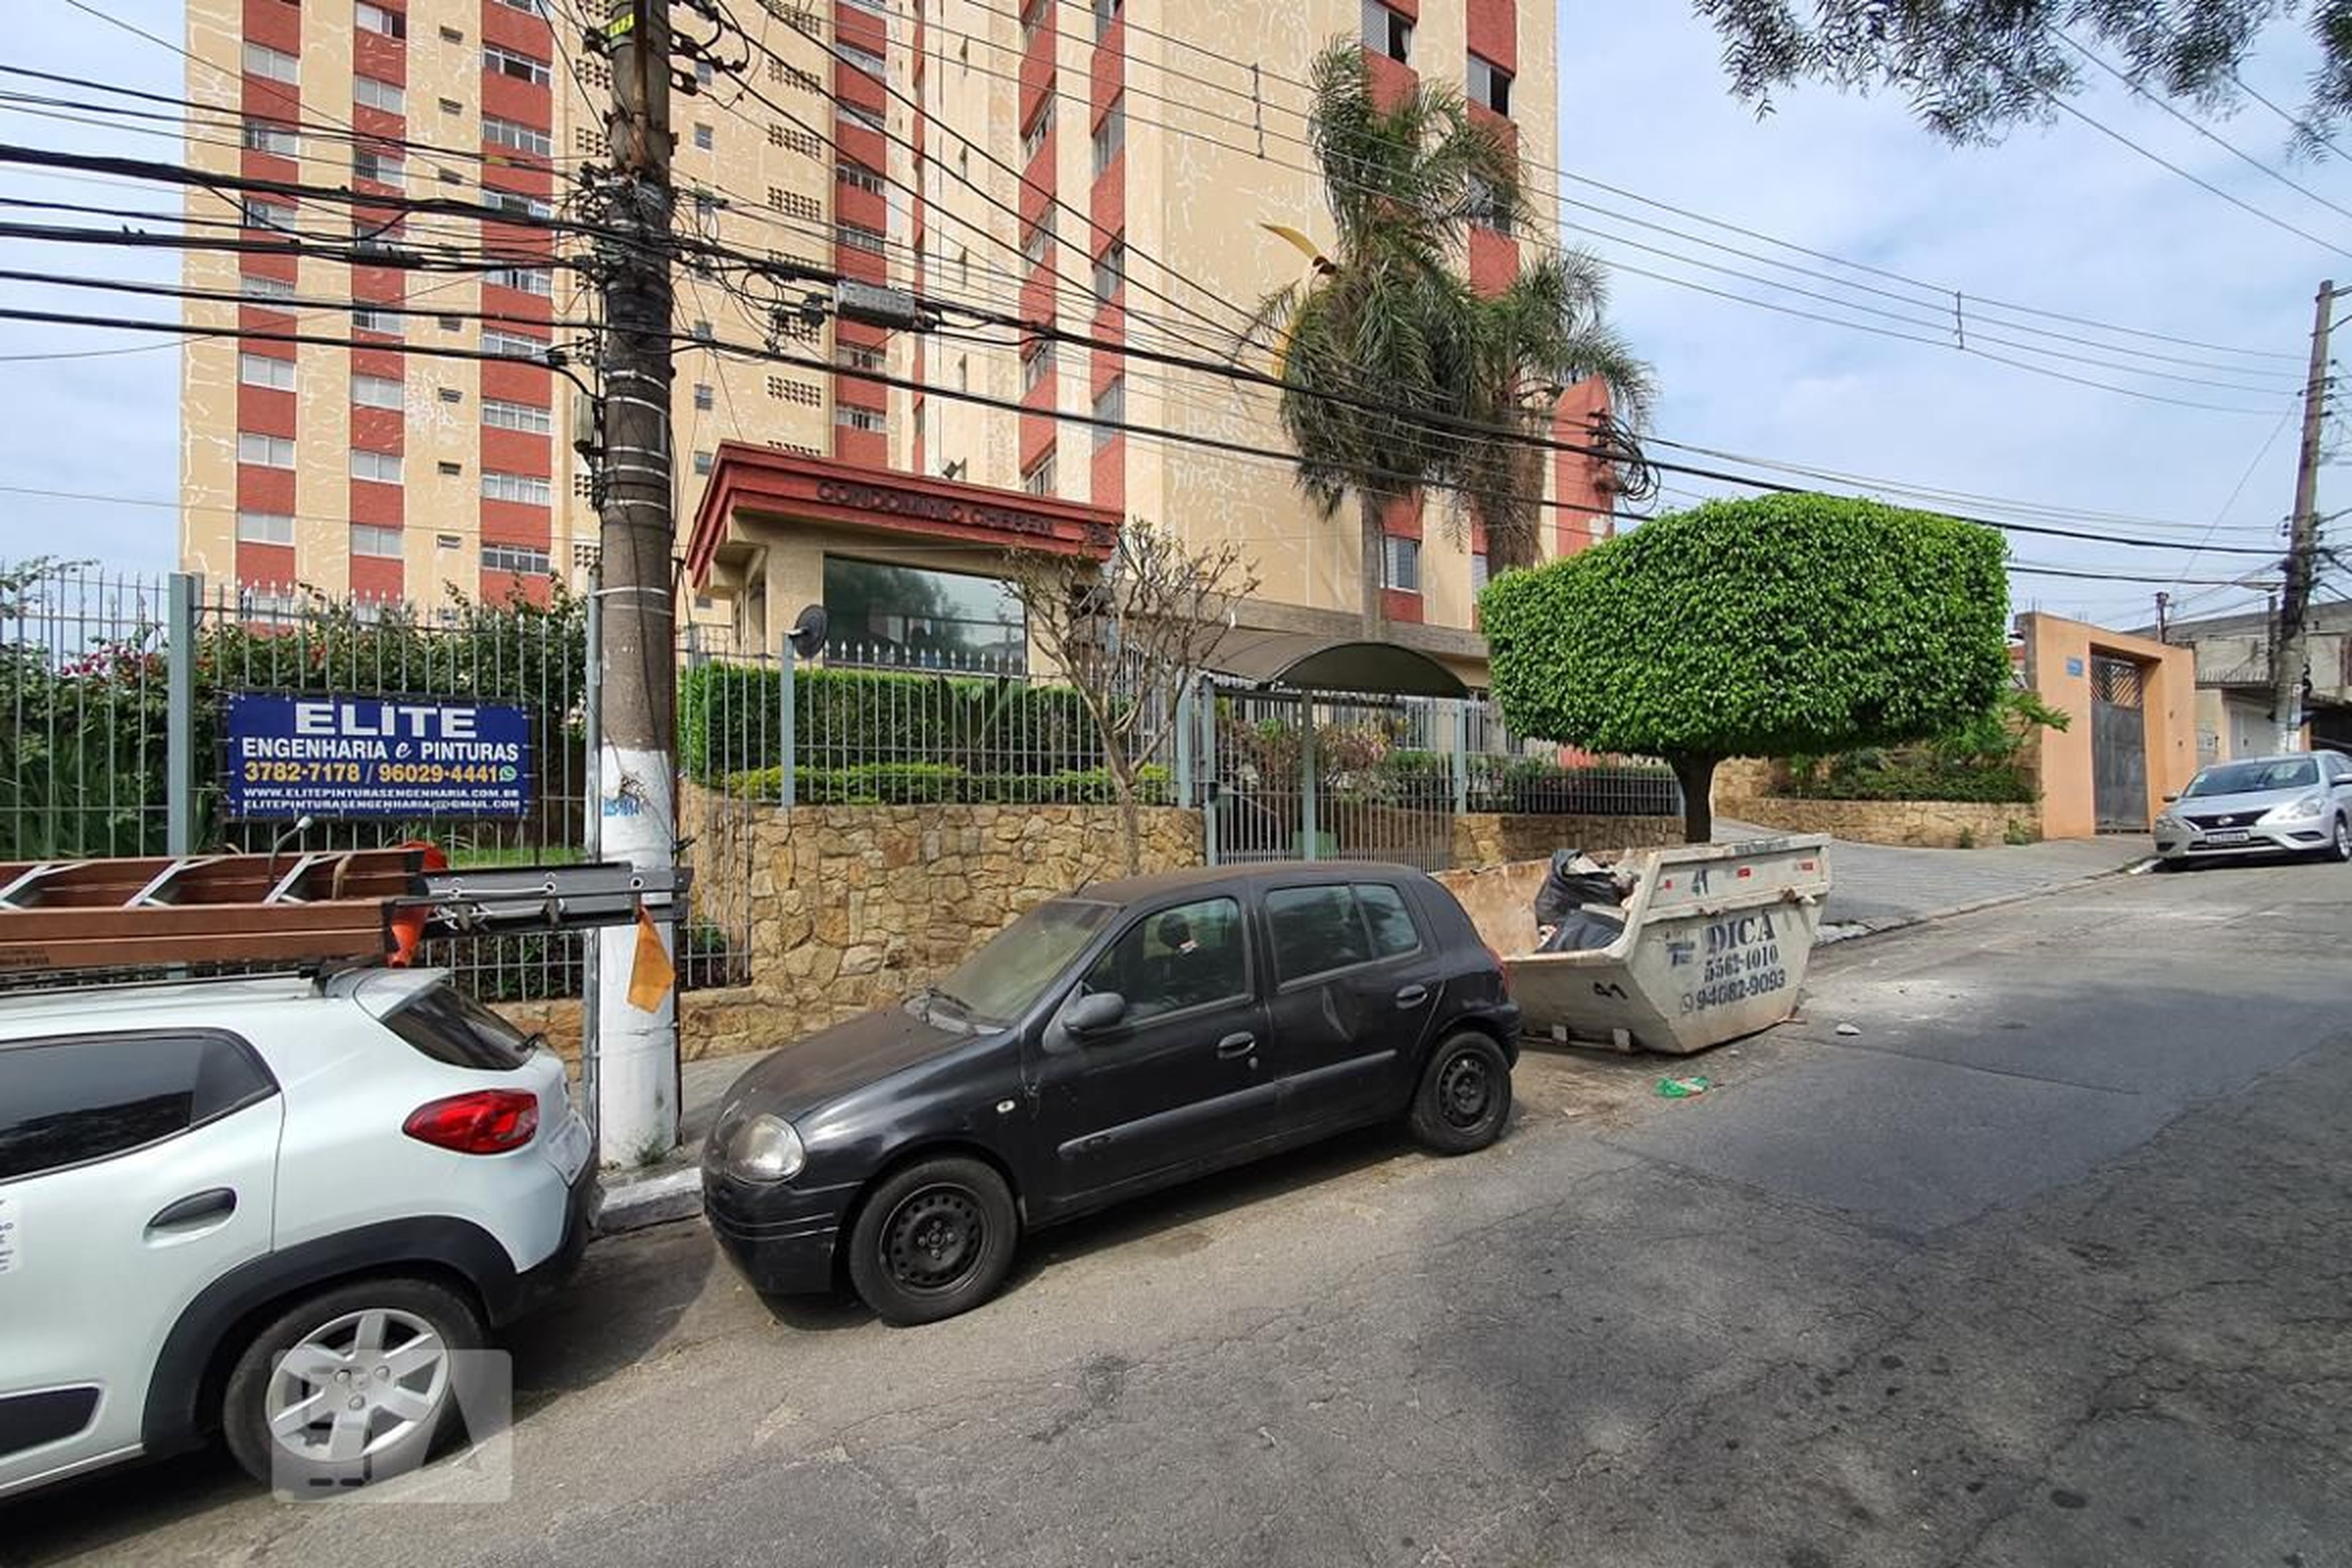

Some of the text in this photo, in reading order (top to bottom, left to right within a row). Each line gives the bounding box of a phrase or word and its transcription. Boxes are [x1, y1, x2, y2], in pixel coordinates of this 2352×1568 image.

[295, 703, 477, 737] ELITE
[243, 737, 387, 760] ENGENHARIA
[421, 742, 519, 762] PINTURAS
[244, 762, 360, 782] 3782-7178
[1704, 909, 1776, 954] DICA
